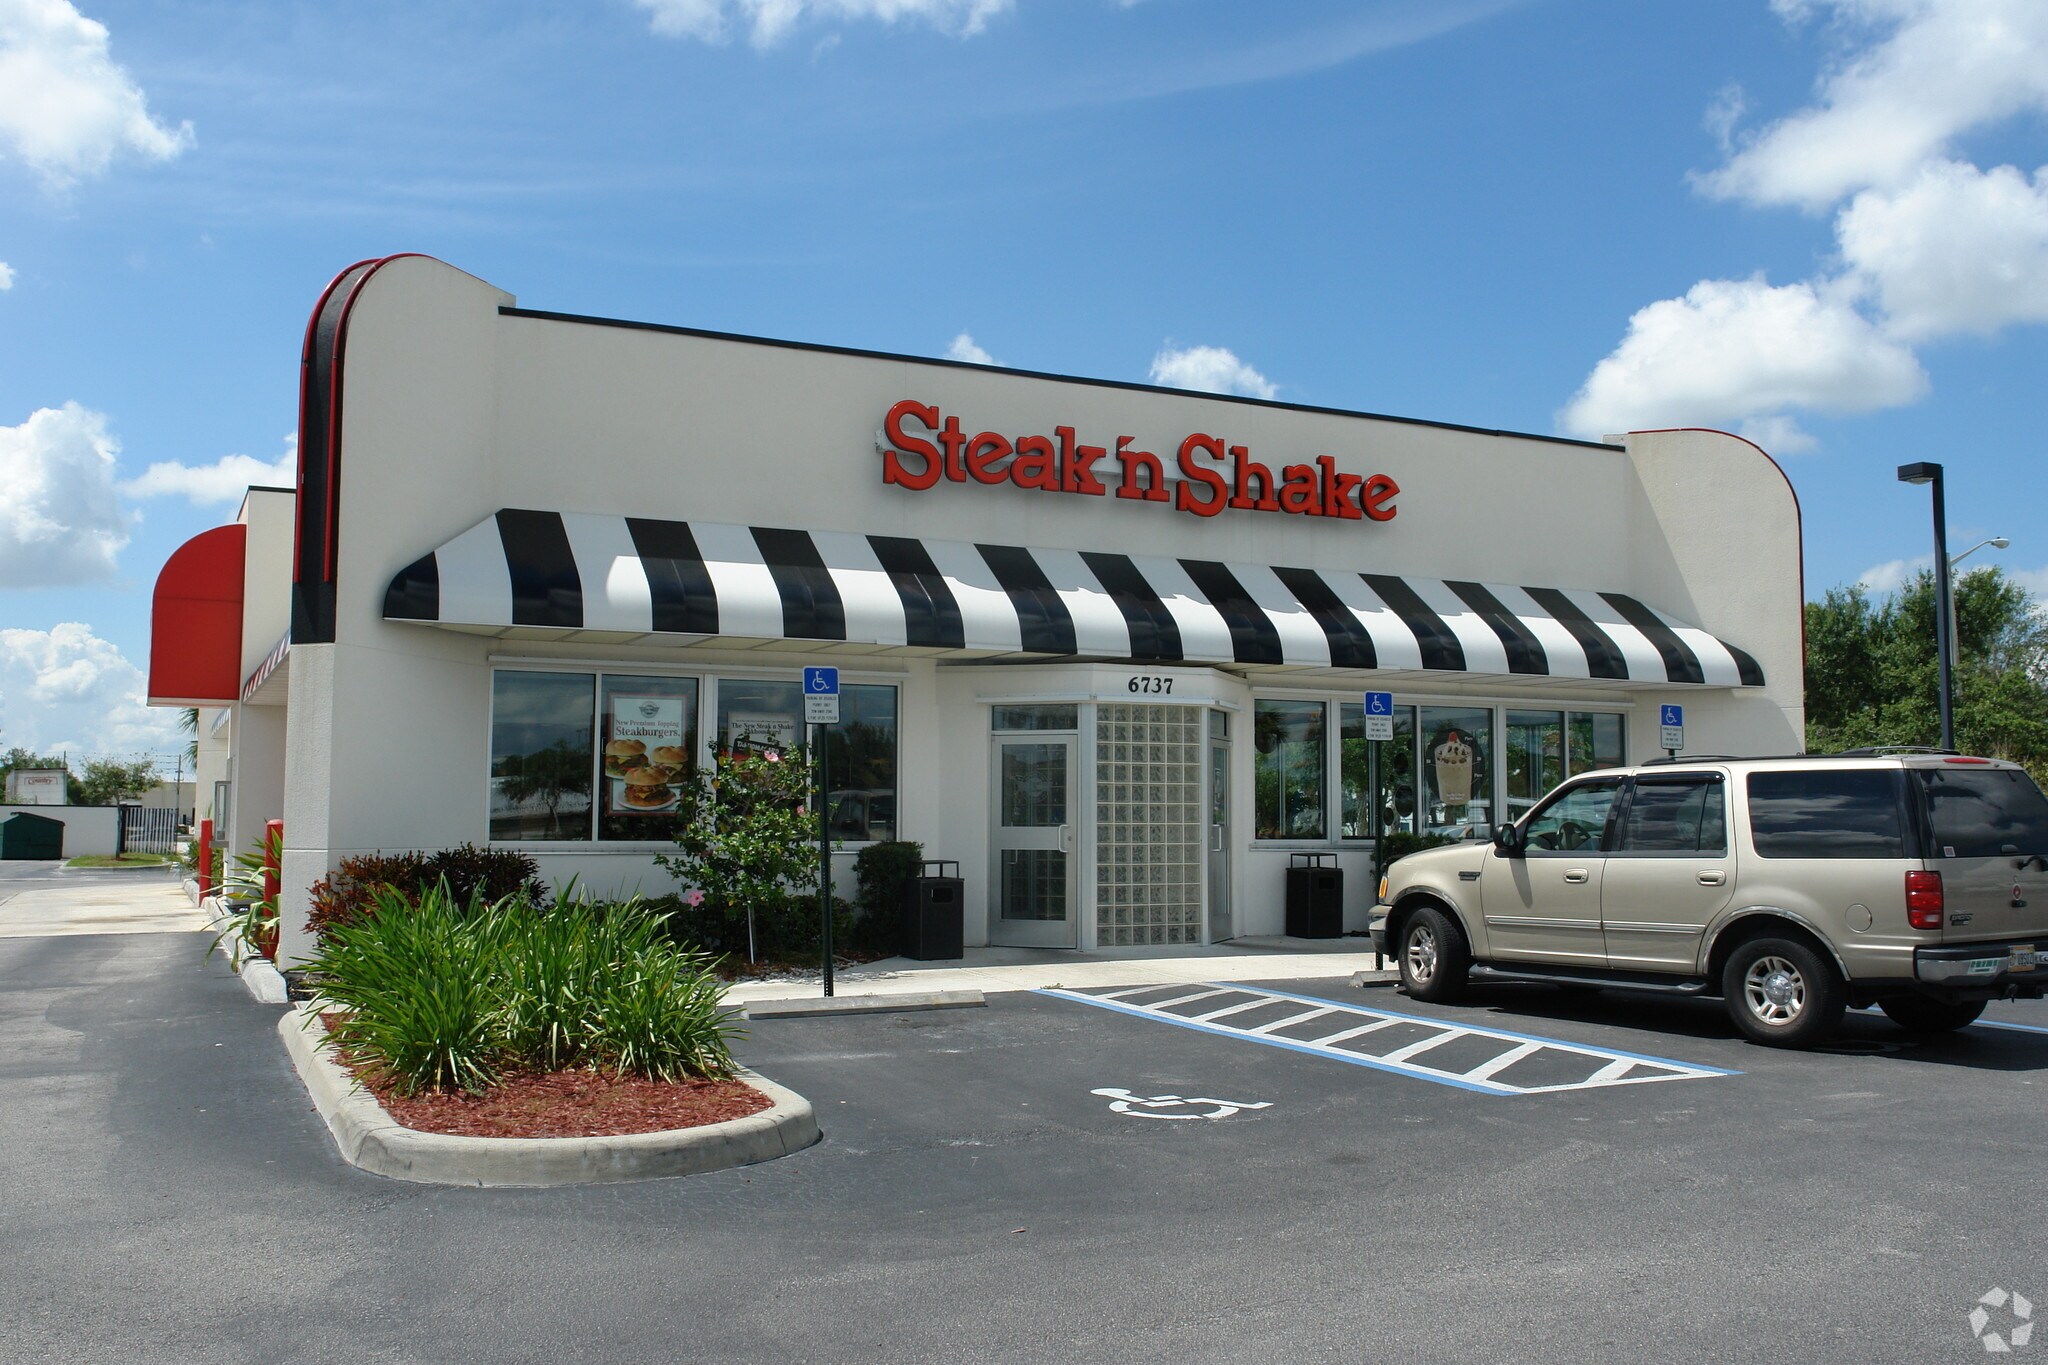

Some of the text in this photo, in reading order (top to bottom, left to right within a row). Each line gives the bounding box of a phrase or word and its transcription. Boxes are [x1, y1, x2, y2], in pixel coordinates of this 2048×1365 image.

[883, 399, 1106, 496] Steak
[1176, 433, 1401, 521] Shake
[1128, 676, 1174, 694] 6737
